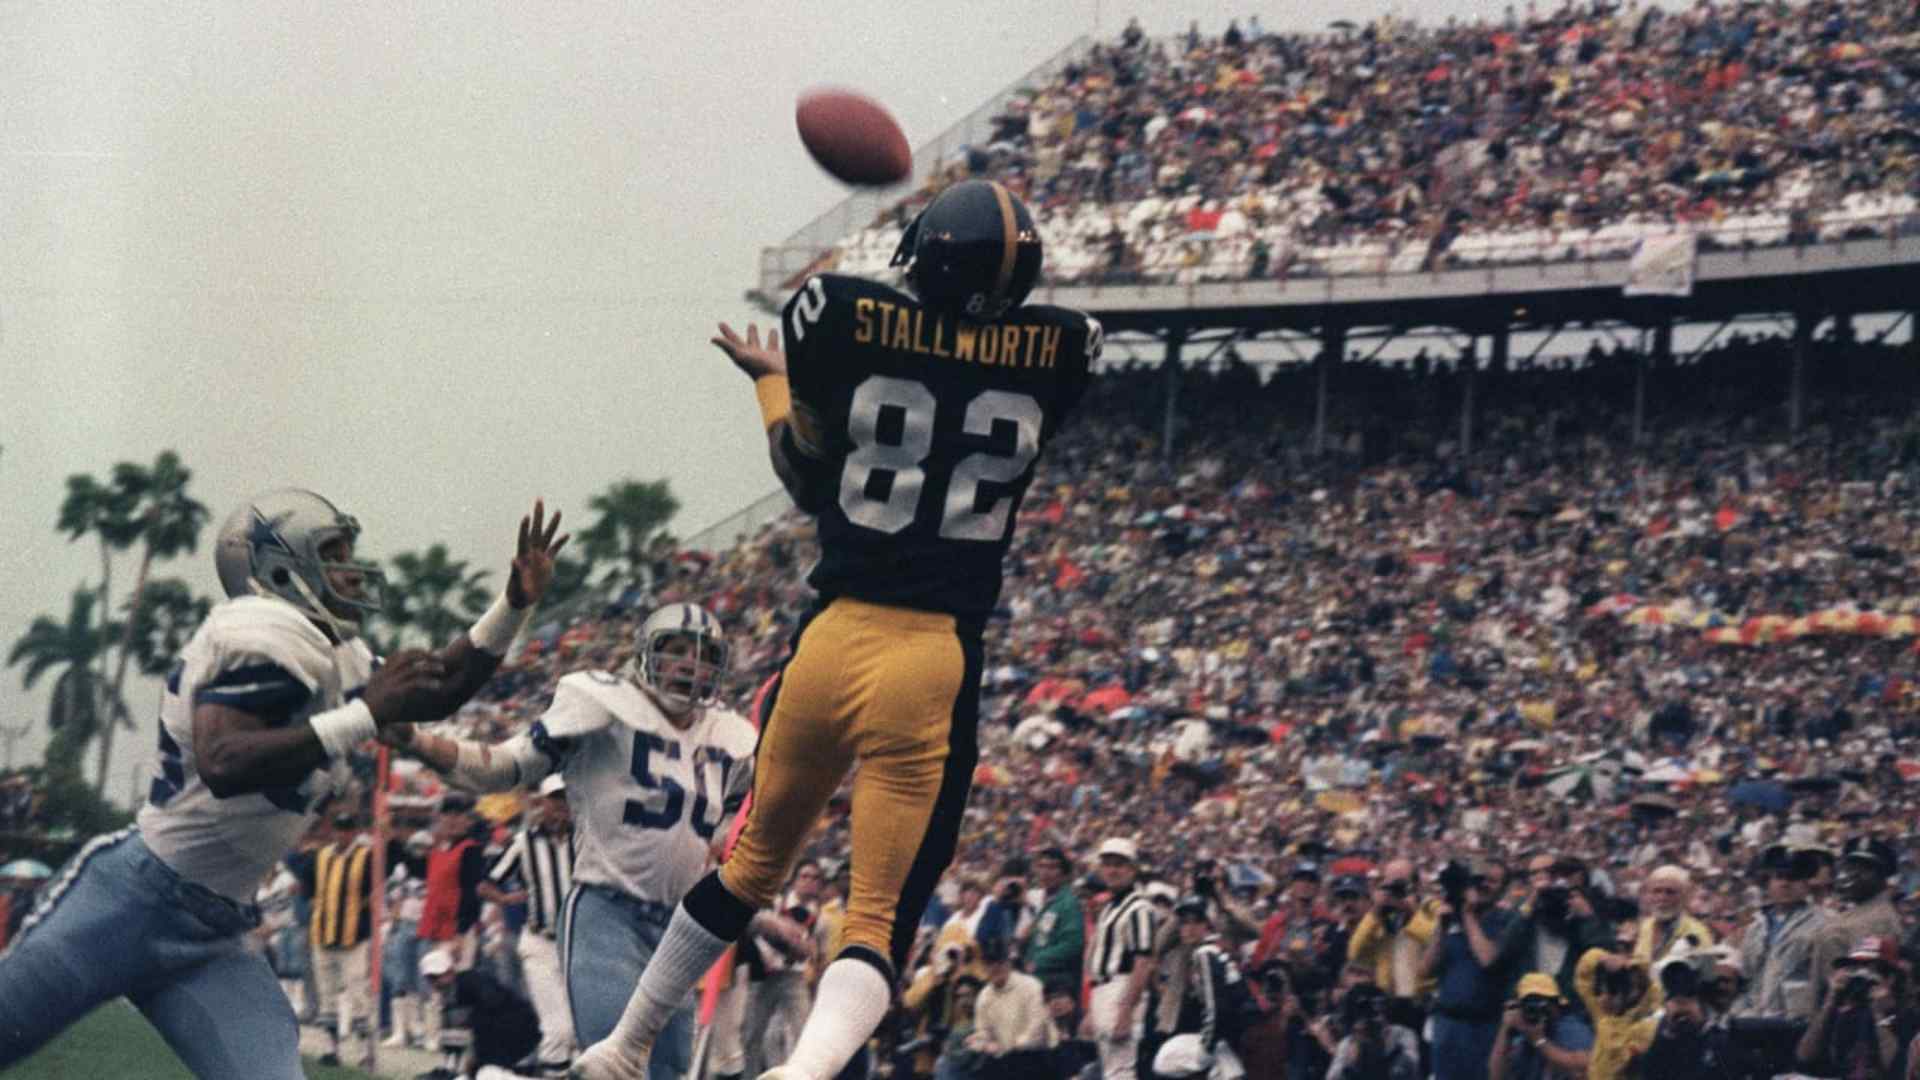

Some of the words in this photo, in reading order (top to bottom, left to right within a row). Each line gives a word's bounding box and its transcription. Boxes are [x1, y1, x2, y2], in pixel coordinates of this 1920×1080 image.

[855, 297, 1062, 368] STALLWORTH
[839, 374, 1043, 541] 82
[623, 730, 735, 840] 50
